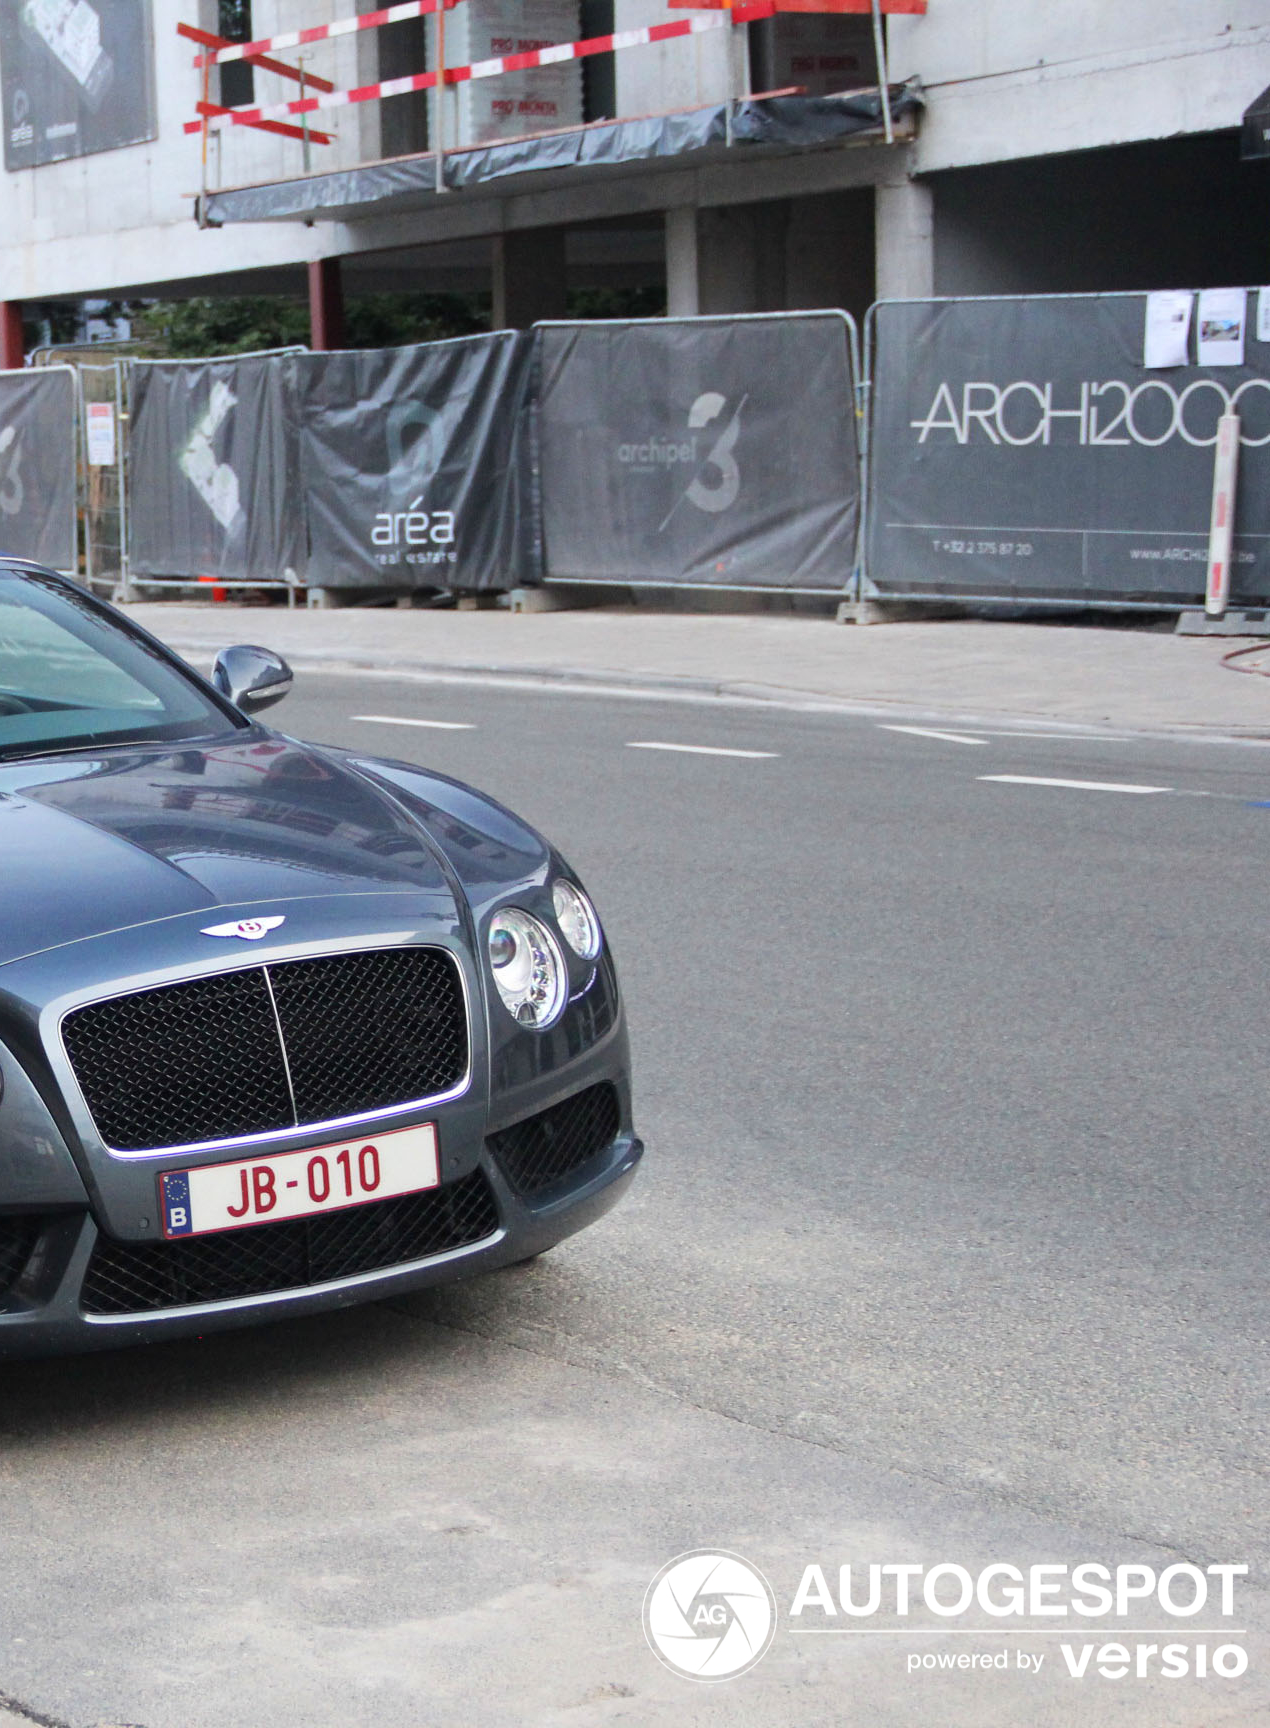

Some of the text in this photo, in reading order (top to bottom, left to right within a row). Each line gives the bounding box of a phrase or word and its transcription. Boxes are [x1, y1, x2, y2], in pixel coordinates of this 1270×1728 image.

[371, 495, 455, 546] aréa
[227, 1145, 380, 1217] JB-010
[170, 1207, 187, 1227] B
